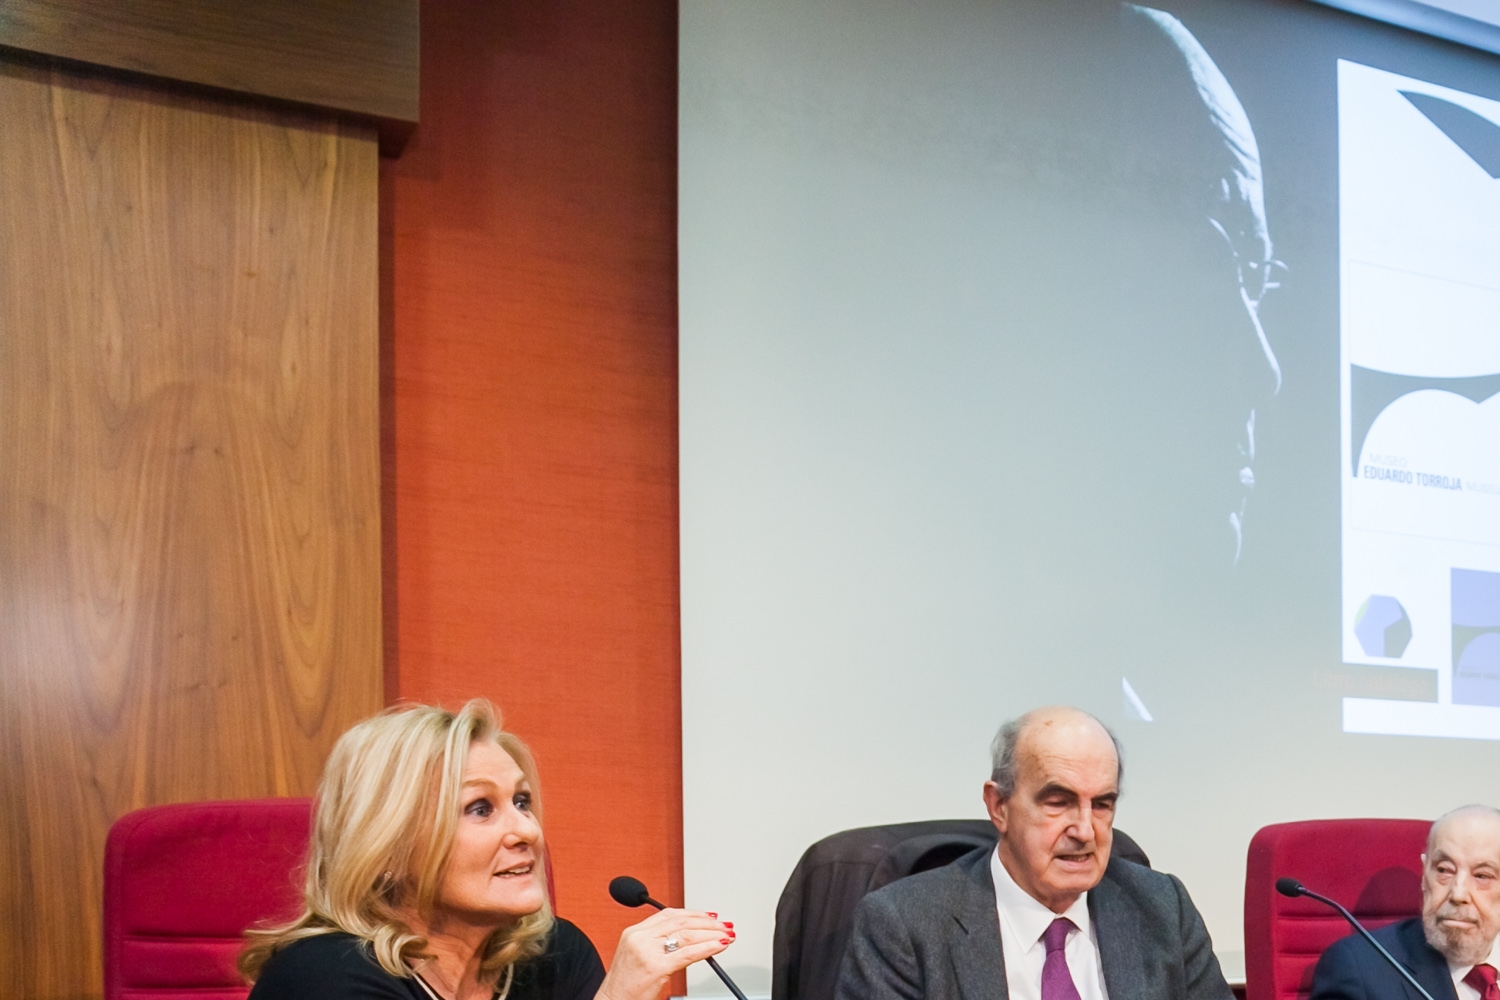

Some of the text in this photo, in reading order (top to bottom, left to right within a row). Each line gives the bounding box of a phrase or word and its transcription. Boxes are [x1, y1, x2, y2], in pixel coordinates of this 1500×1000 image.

[1369, 452, 1408, 468] MUSEO
[1363, 465, 1413, 485] EDUARDO
[1415, 472, 1463, 492] TORROJA
